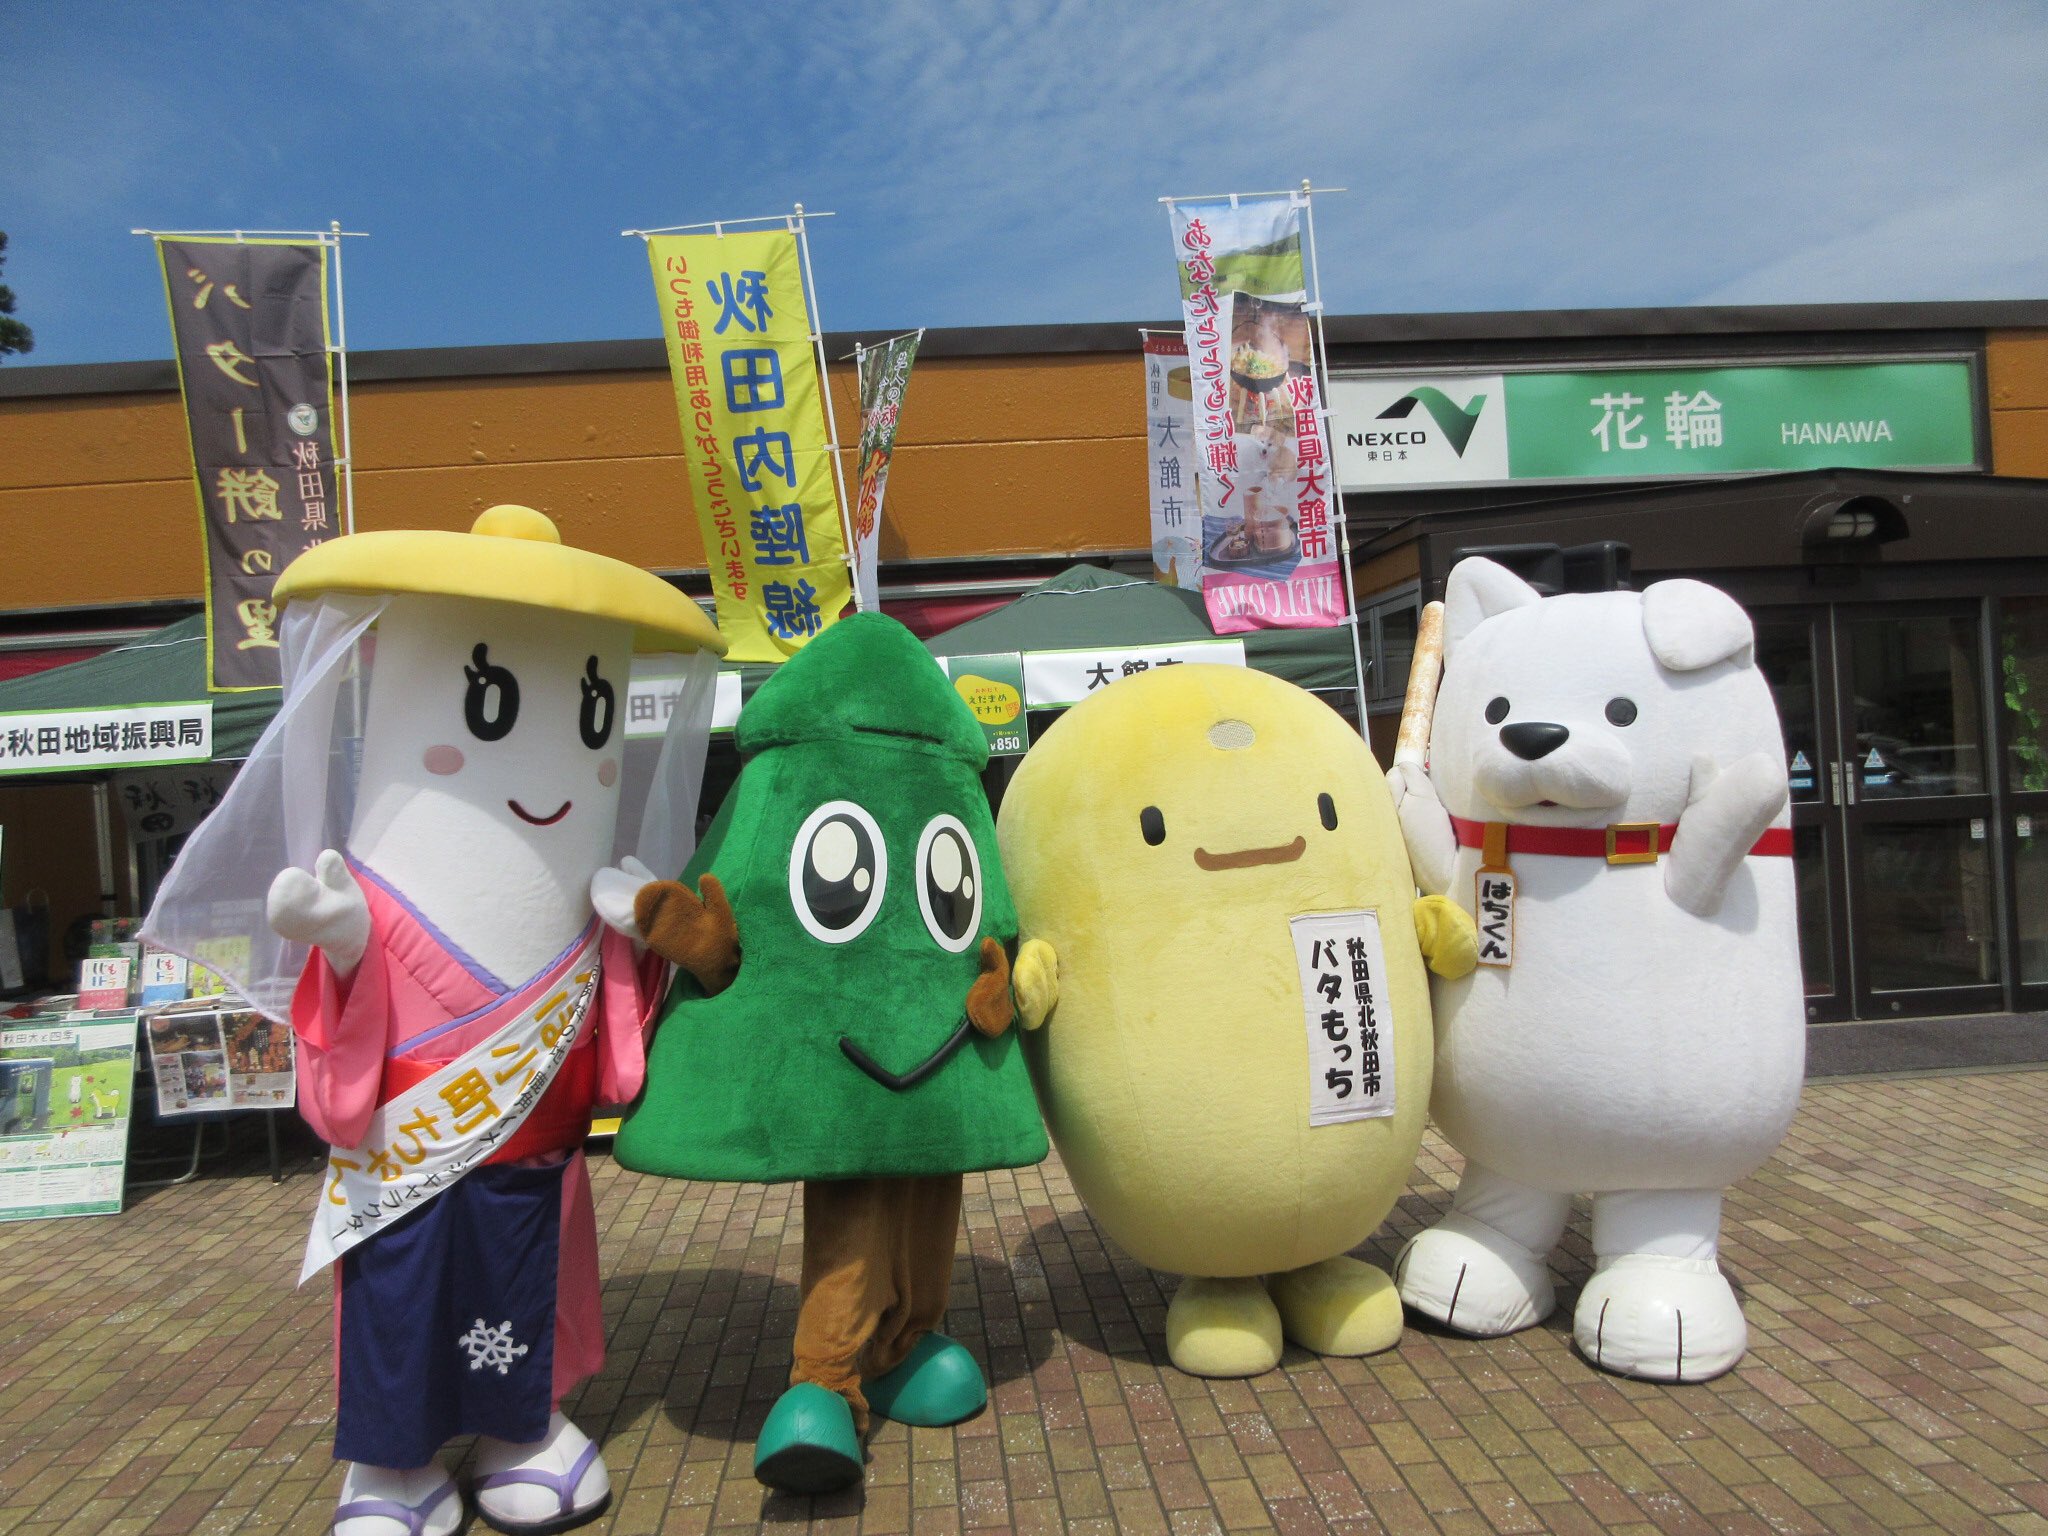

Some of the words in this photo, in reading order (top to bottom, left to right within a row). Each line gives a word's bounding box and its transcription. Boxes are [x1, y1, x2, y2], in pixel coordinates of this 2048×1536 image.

[1347, 431, 1427, 446] NEXCO
[1590, 390, 1723, 453] 花輪
[1781, 420, 1894, 446] HANAWA
[1367, 450, 1409, 462] 東日本
[855, 450, 886, 567] 大館
[969, 694, 1008, 705] えだまめ
[1086, 658, 1184, 691] 大館
[0, 717, 205, 758] 秋田地域振興局
[990, 737, 1020, 752] ¥850
[1480, 880, 1512, 961] はちくん
[1311, 938, 1354, 1099] バタもっち
[1346, 937, 1381, 1097] 秋田県北秋田市
[328, 967, 593, 1206] ぽ小町ちゃん
[332, 965, 601, 1240] 発祥の地・鹿角イメージキャラクター
